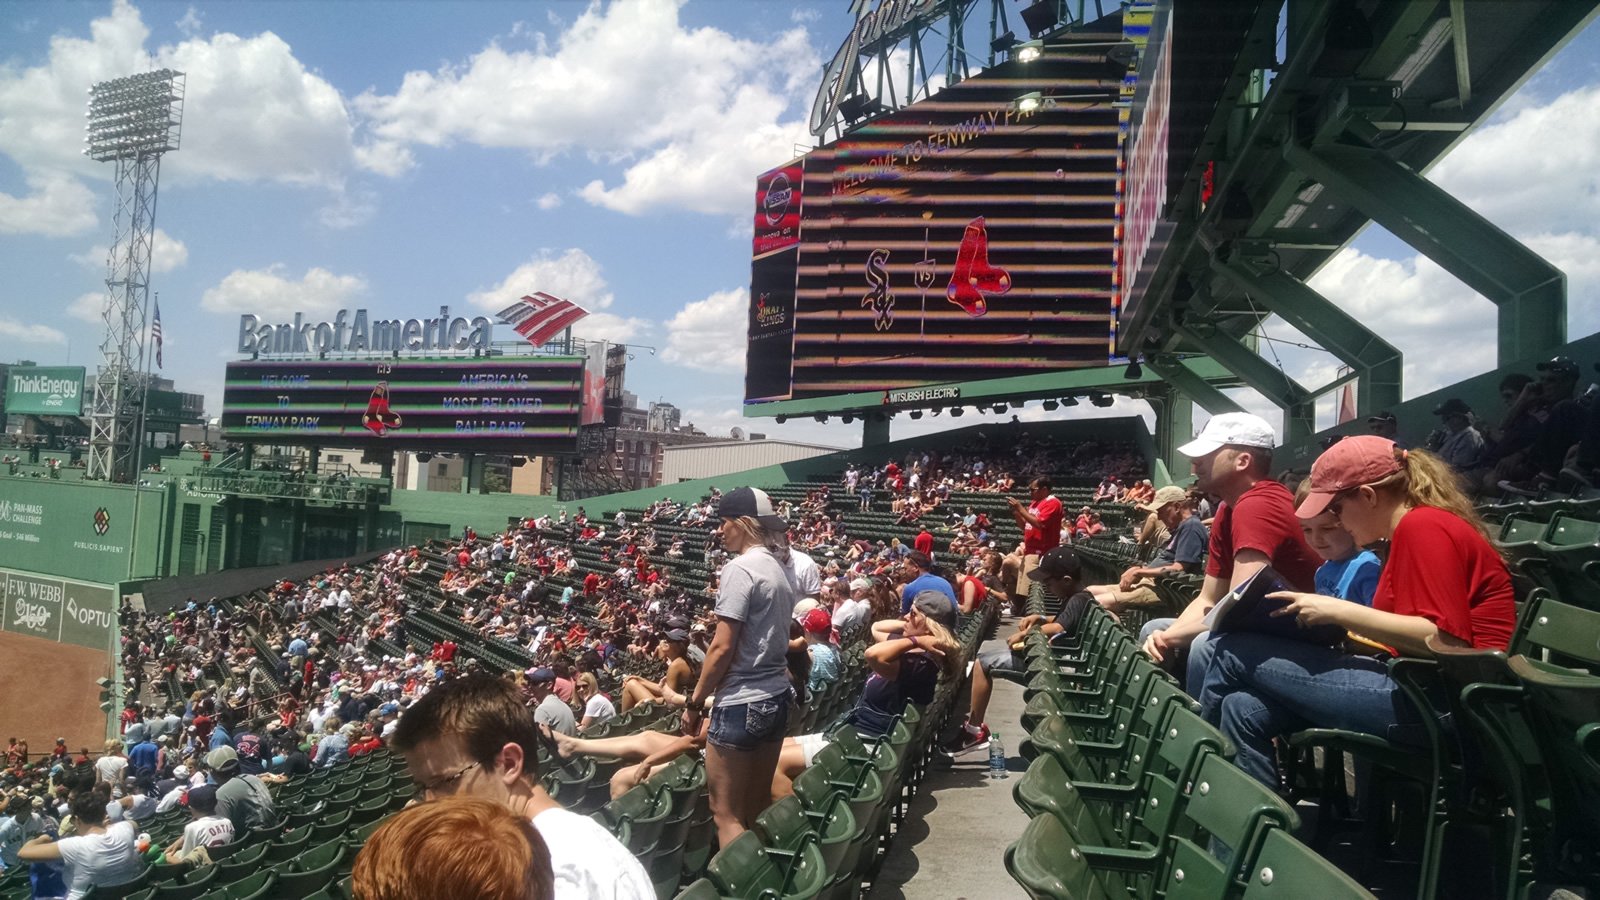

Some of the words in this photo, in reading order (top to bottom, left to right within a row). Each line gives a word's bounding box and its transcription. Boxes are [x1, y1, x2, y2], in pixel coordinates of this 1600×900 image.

[904, 141, 922, 165] TO
[928, 108, 1000, 154] FENWAY
[919, 271, 931, 283] VS
[238, 311, 314, 354] Bank
[313, 309, 348, 354] of
[347, 305, 493, 353] America
[376, 363, 392, 375] 1:13
[13, 375, 78, 399] ThinkEnergy
[261, 374, 310, 388] WELCOME
[459, 372, 529, 389] AMERICA'S
[277, 395, 290, 409] TO
[890, 389, 926, 403] MITSUBISHI
[925, 387, 959, 400] ELECTRIC
[443, 397, 477, 409] MOST
[482, 397, 543, 413] BELOVED
[245, 415, 288, 431] FENWAY
[290, 416, 320, 431] PARK
[13, 503, 43, 515] PAN-MASS
[13, 513, 42, 525] CHALLENGE
[9, 579, 28, 597] F.W.
[30, 582, 61, 603] WEBB
[26, 603, 47, 628] 150
